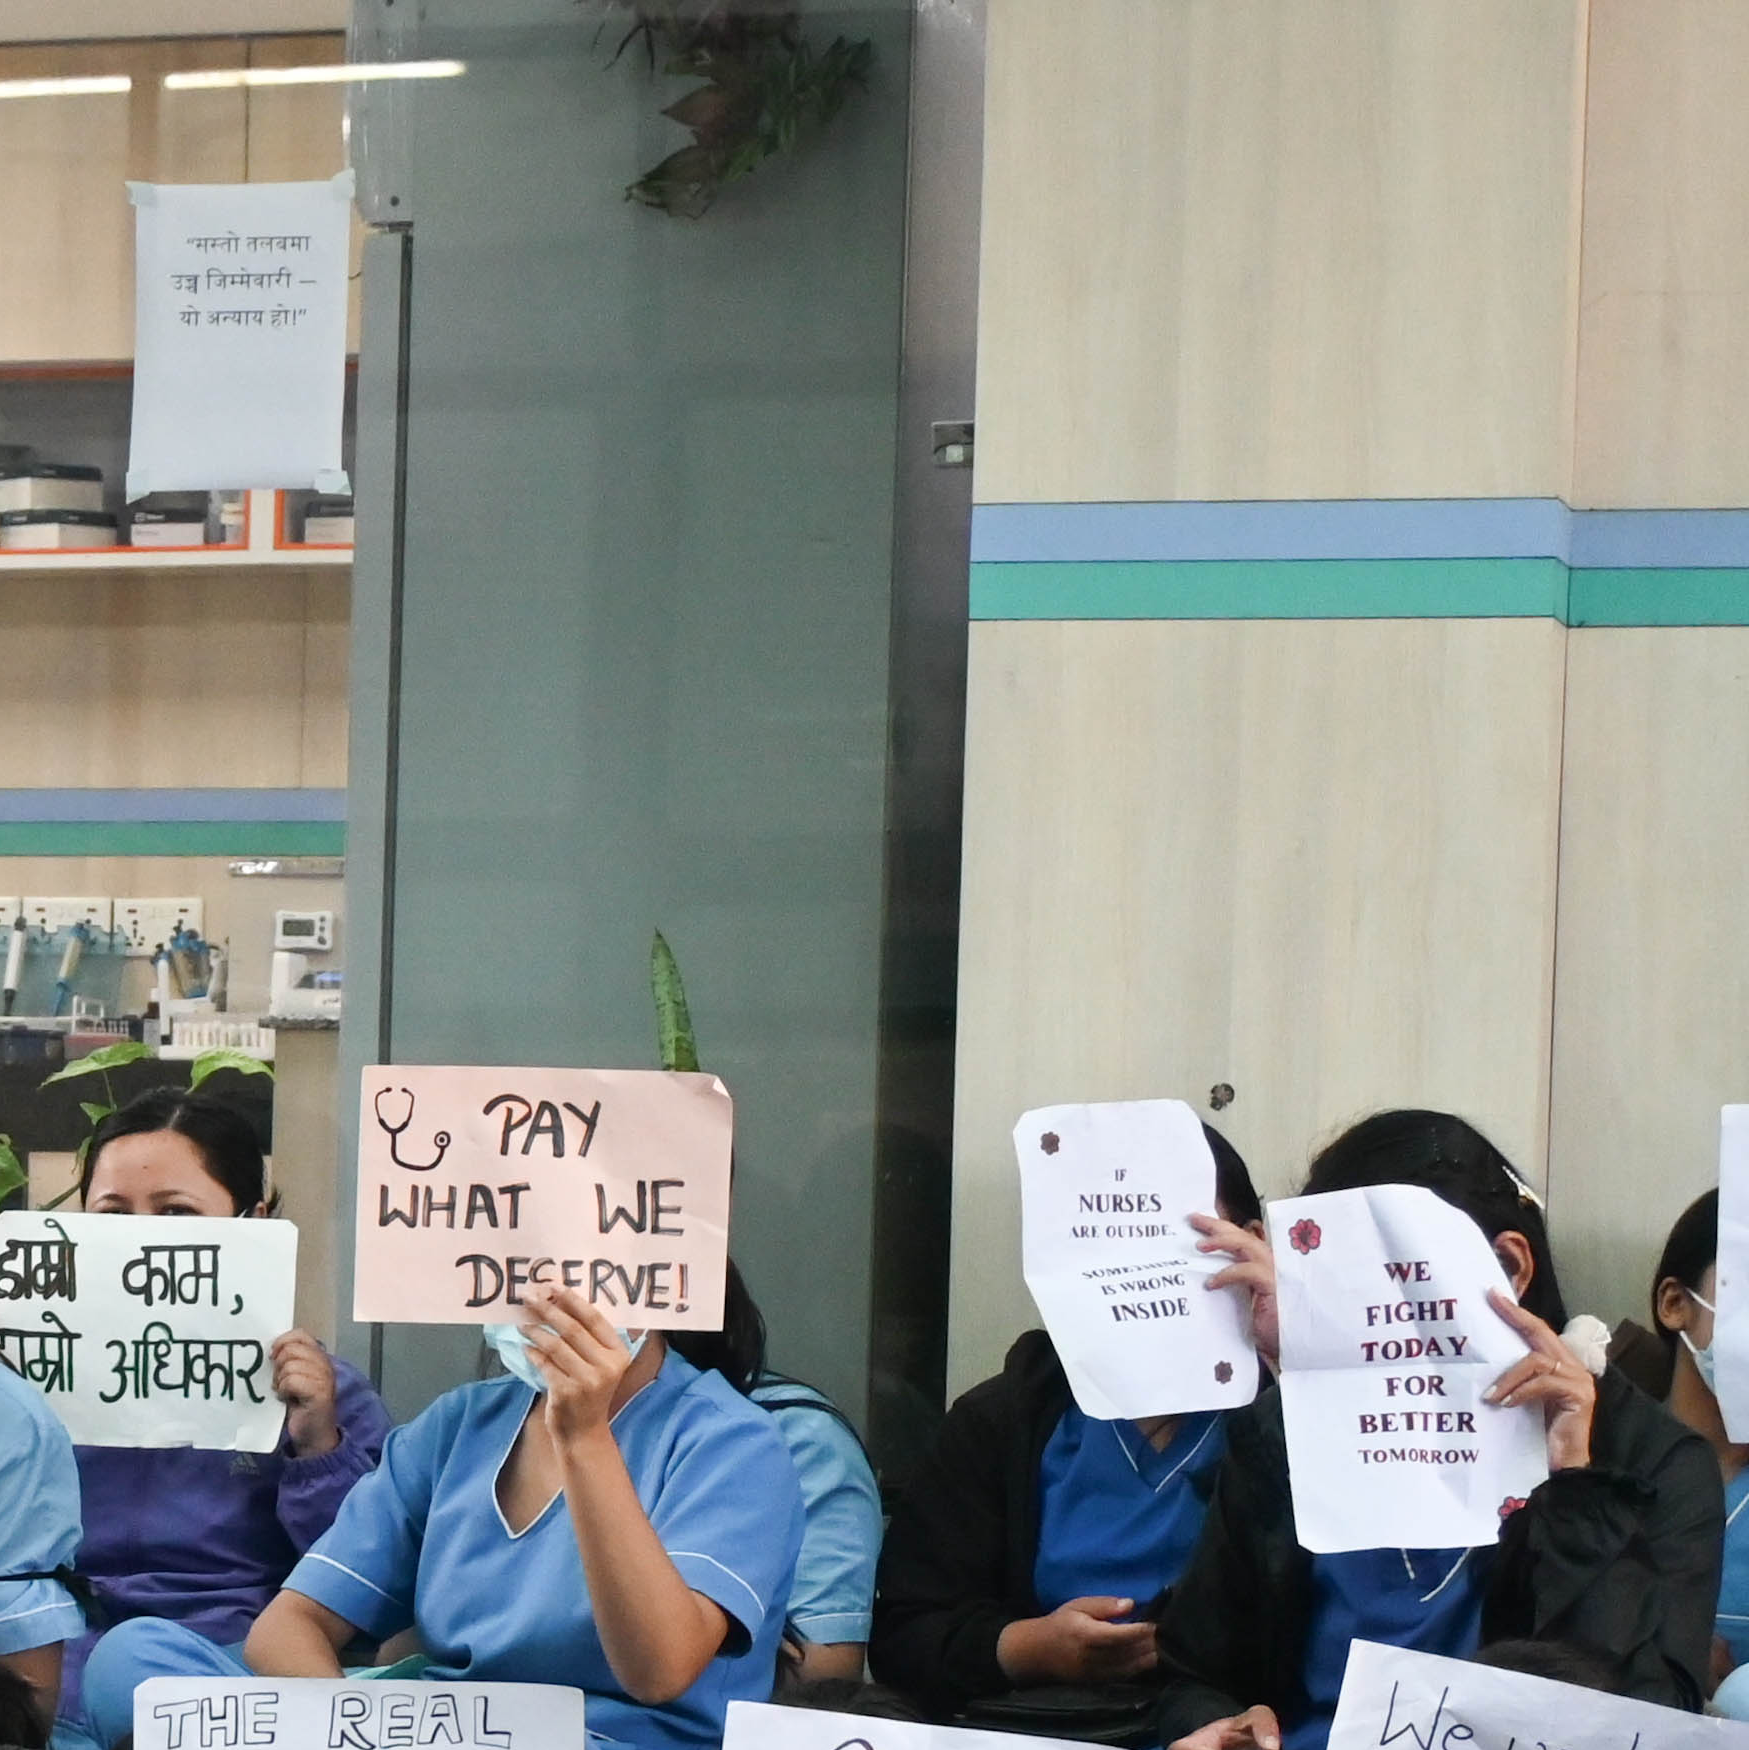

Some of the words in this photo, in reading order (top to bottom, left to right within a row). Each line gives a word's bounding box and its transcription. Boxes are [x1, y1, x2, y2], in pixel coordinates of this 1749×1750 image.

[179, 305, 201, 327] यो
[206, 310, 265, 327] अन्याय
[483, 1093, 600, 1158] PAY
[1114, 1168, 1127, 1182] IF
[378, 1182, 530, 1230] WHAT
[595, 1179, 685, 1236] WE
[1078, 1192, 1162, 1213] NURSES
[1069, 1225, 1100, 1239] ARE
[1081, 1257, 1189, 1280] SOMETHING
[1384, 1260, 1431, 1283] WE
[1101, 1284, 1117, 1296] IS
[1120, 1272, 1186, 1293] WRONG
[1111, 1297, 1190, 1322] INSIDE
[1365, 1298, 1458, 1326] FIGHT
[1361, 1334, 1469, 1363] TODAY
[99, 1321, 265, 1403] अधिकार
[1385, 1374, 1445, 1397] FOR
[1358, 1411, 1477, 1436] BETTER
[1357, 1447, 1480, 1465] TOMORROW
[154, 1691, 280, 1750] THE
